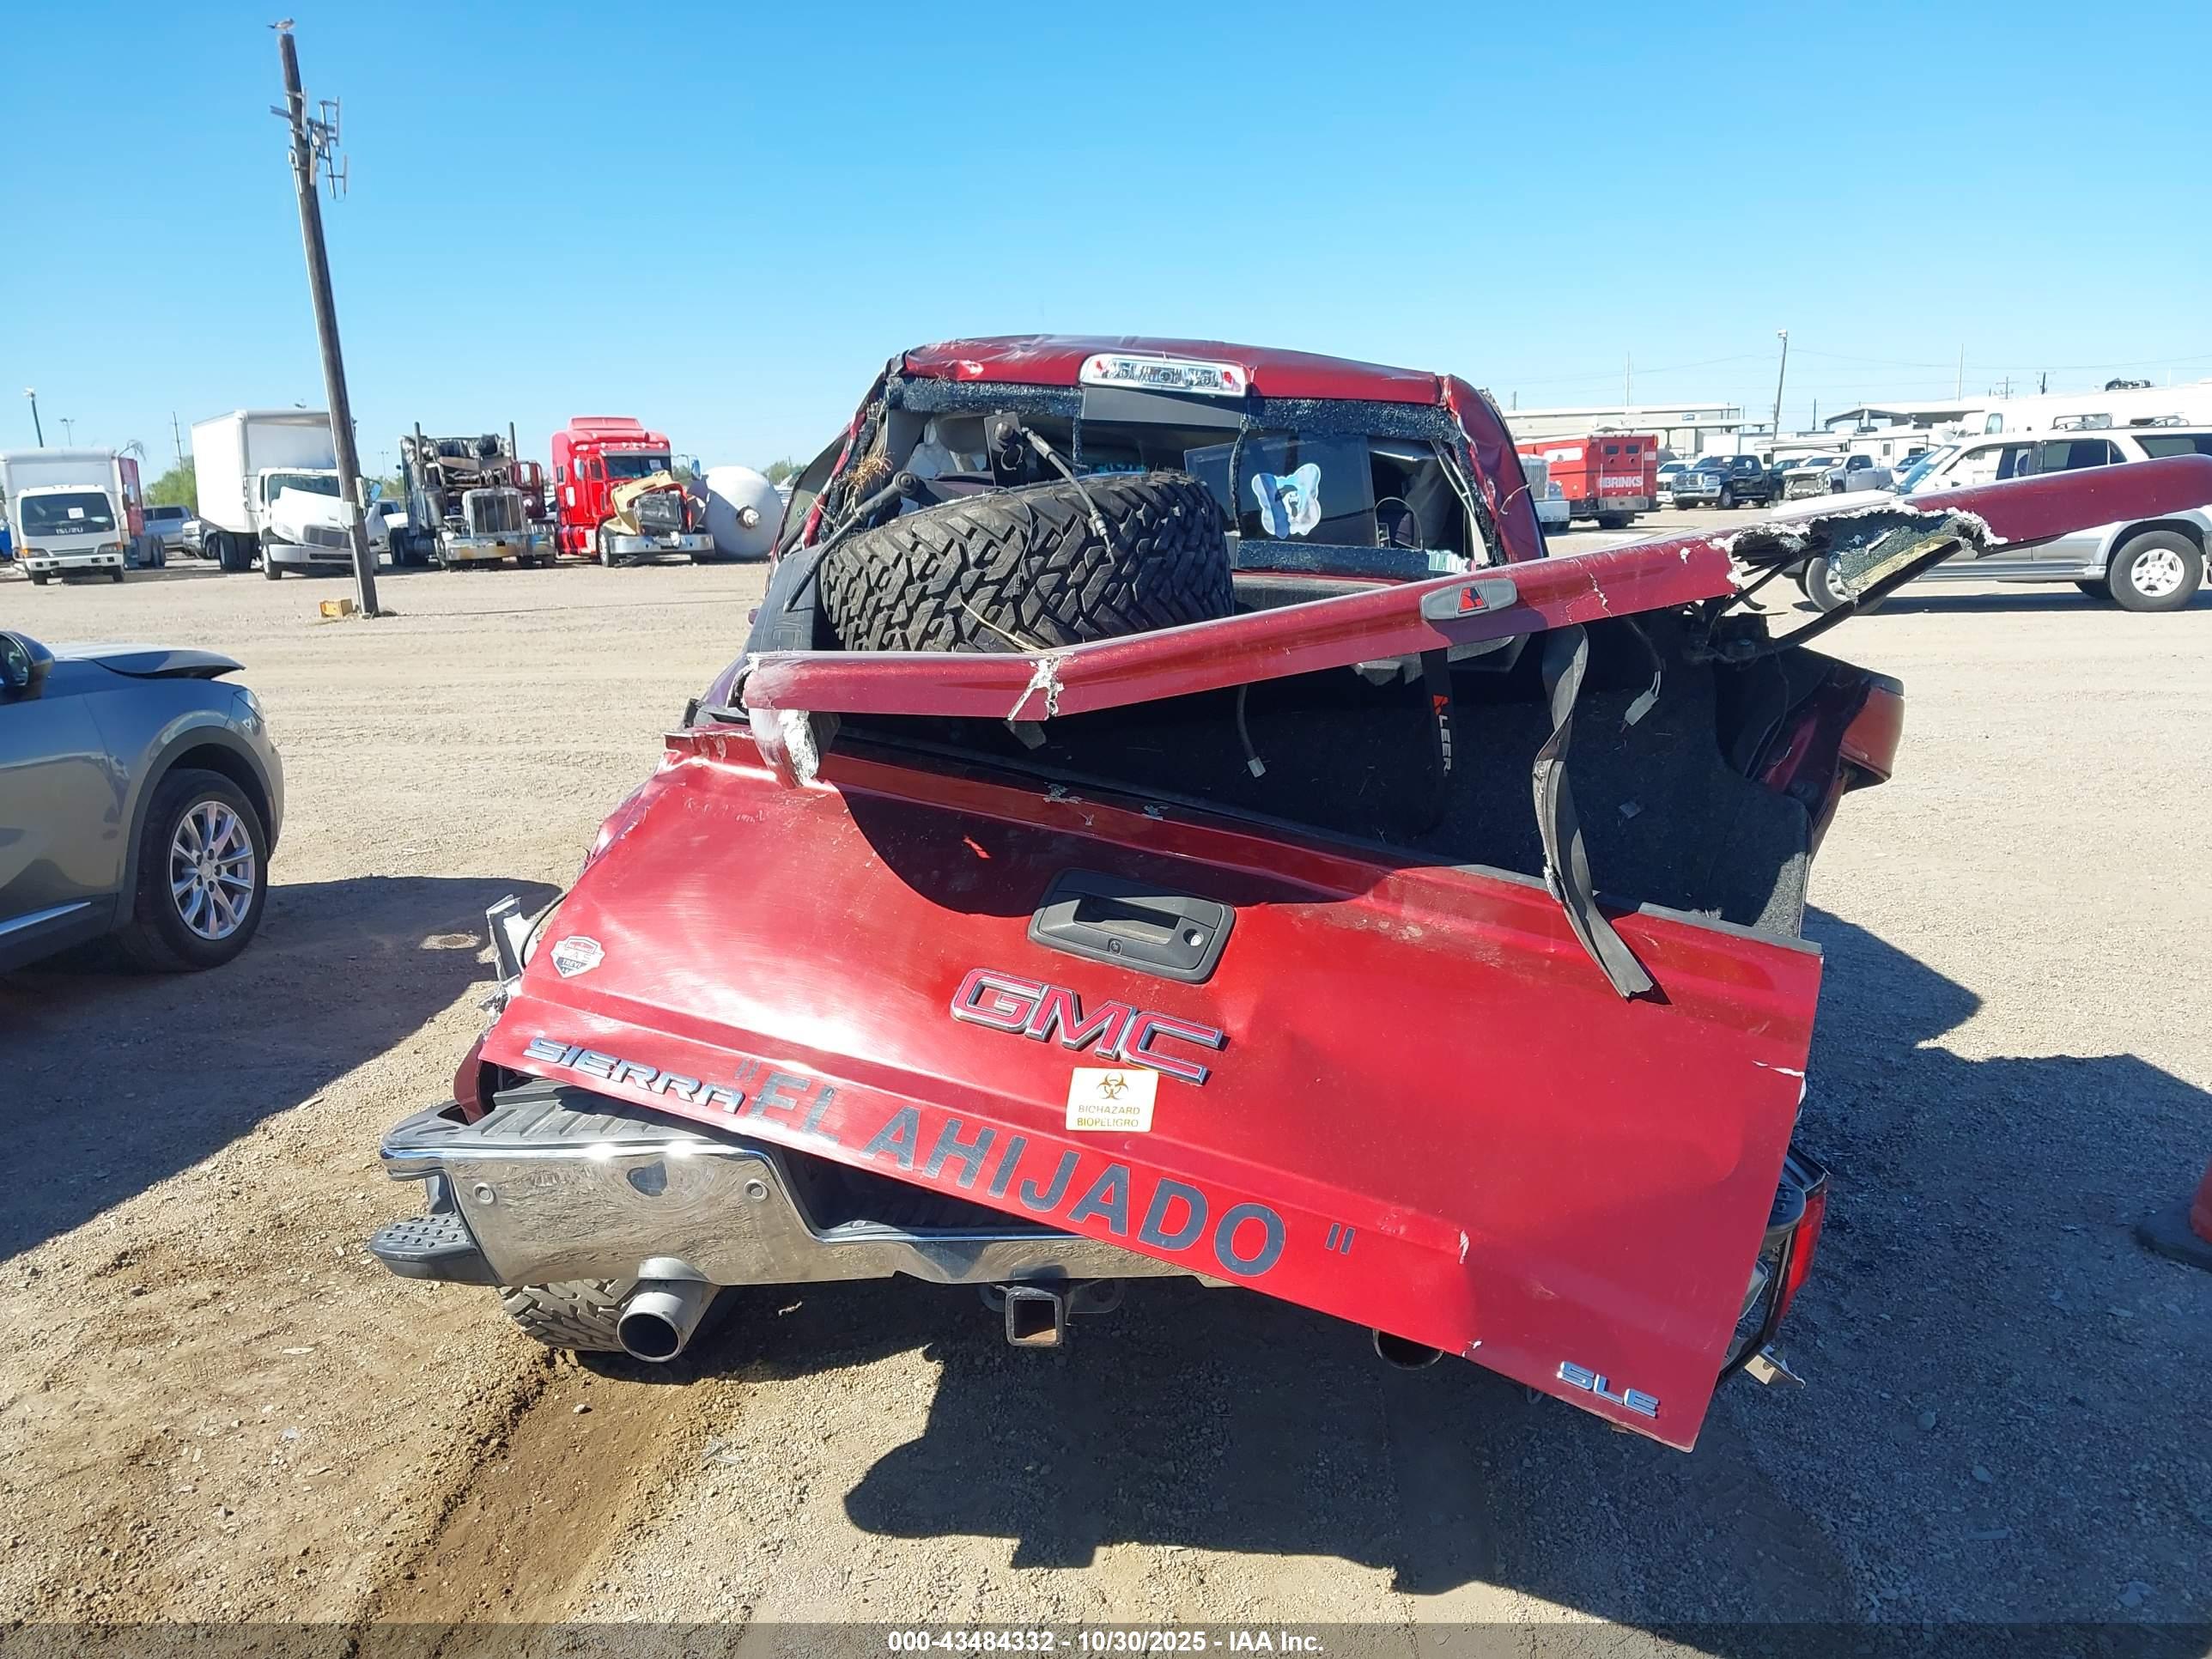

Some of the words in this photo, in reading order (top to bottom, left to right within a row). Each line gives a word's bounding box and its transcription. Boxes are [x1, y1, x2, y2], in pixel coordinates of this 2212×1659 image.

[1606, 476, 1642, 489] BRINKS
[56, 526, 83, 535] ISUZU
[1438, 714, 1452, 770] LEER
[950, 969, 1224, 1085] GMC
[522, 1036, 745, 1115] SIERRA
[1077, 1117, 1139, 1127] BIOPELIGRO
[1078, 1104, 1140, 1115] BIOHAZARD
[858, 1105, 1285, 1276] AHIJADO
[1557, 1361, 1660, 1419] SLE
